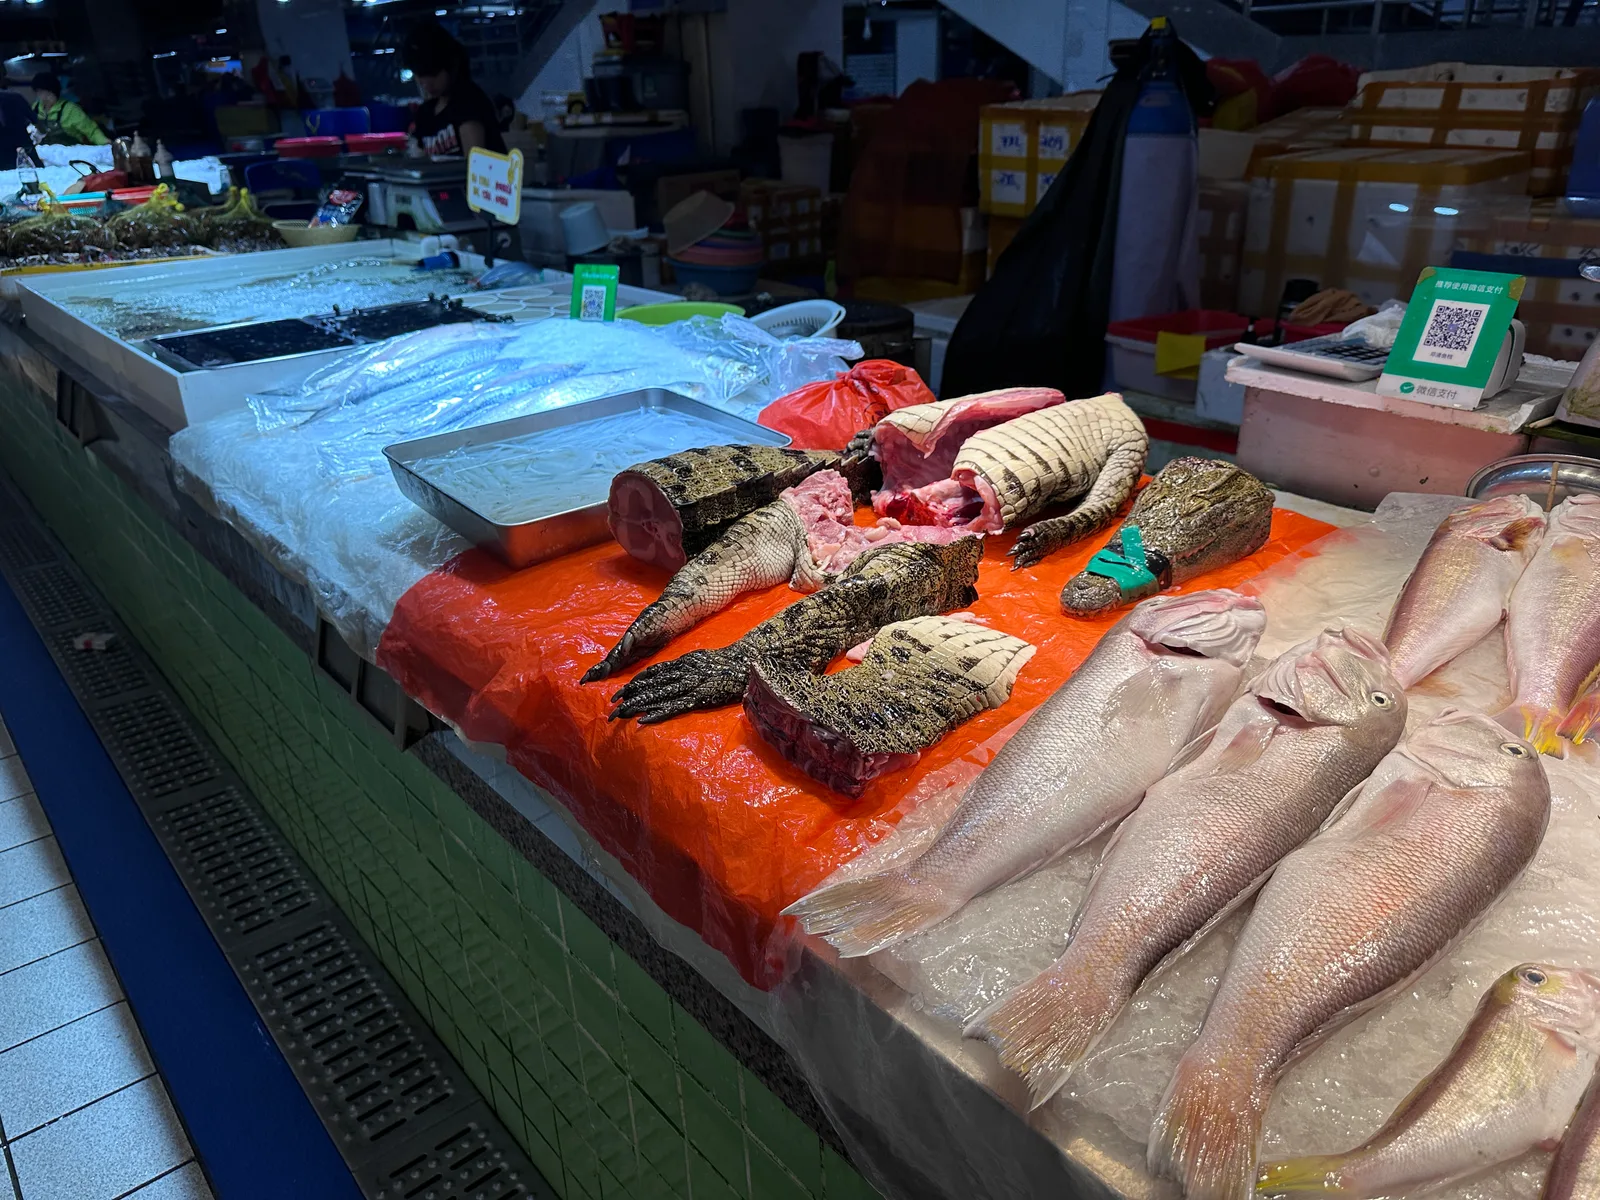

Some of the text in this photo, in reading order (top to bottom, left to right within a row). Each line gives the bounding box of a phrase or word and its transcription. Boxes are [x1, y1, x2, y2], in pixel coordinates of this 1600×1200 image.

[1435, 280, 1503, 294] 推荐使用微信支付
[1416, 385, 1457, 399] 微信支付
